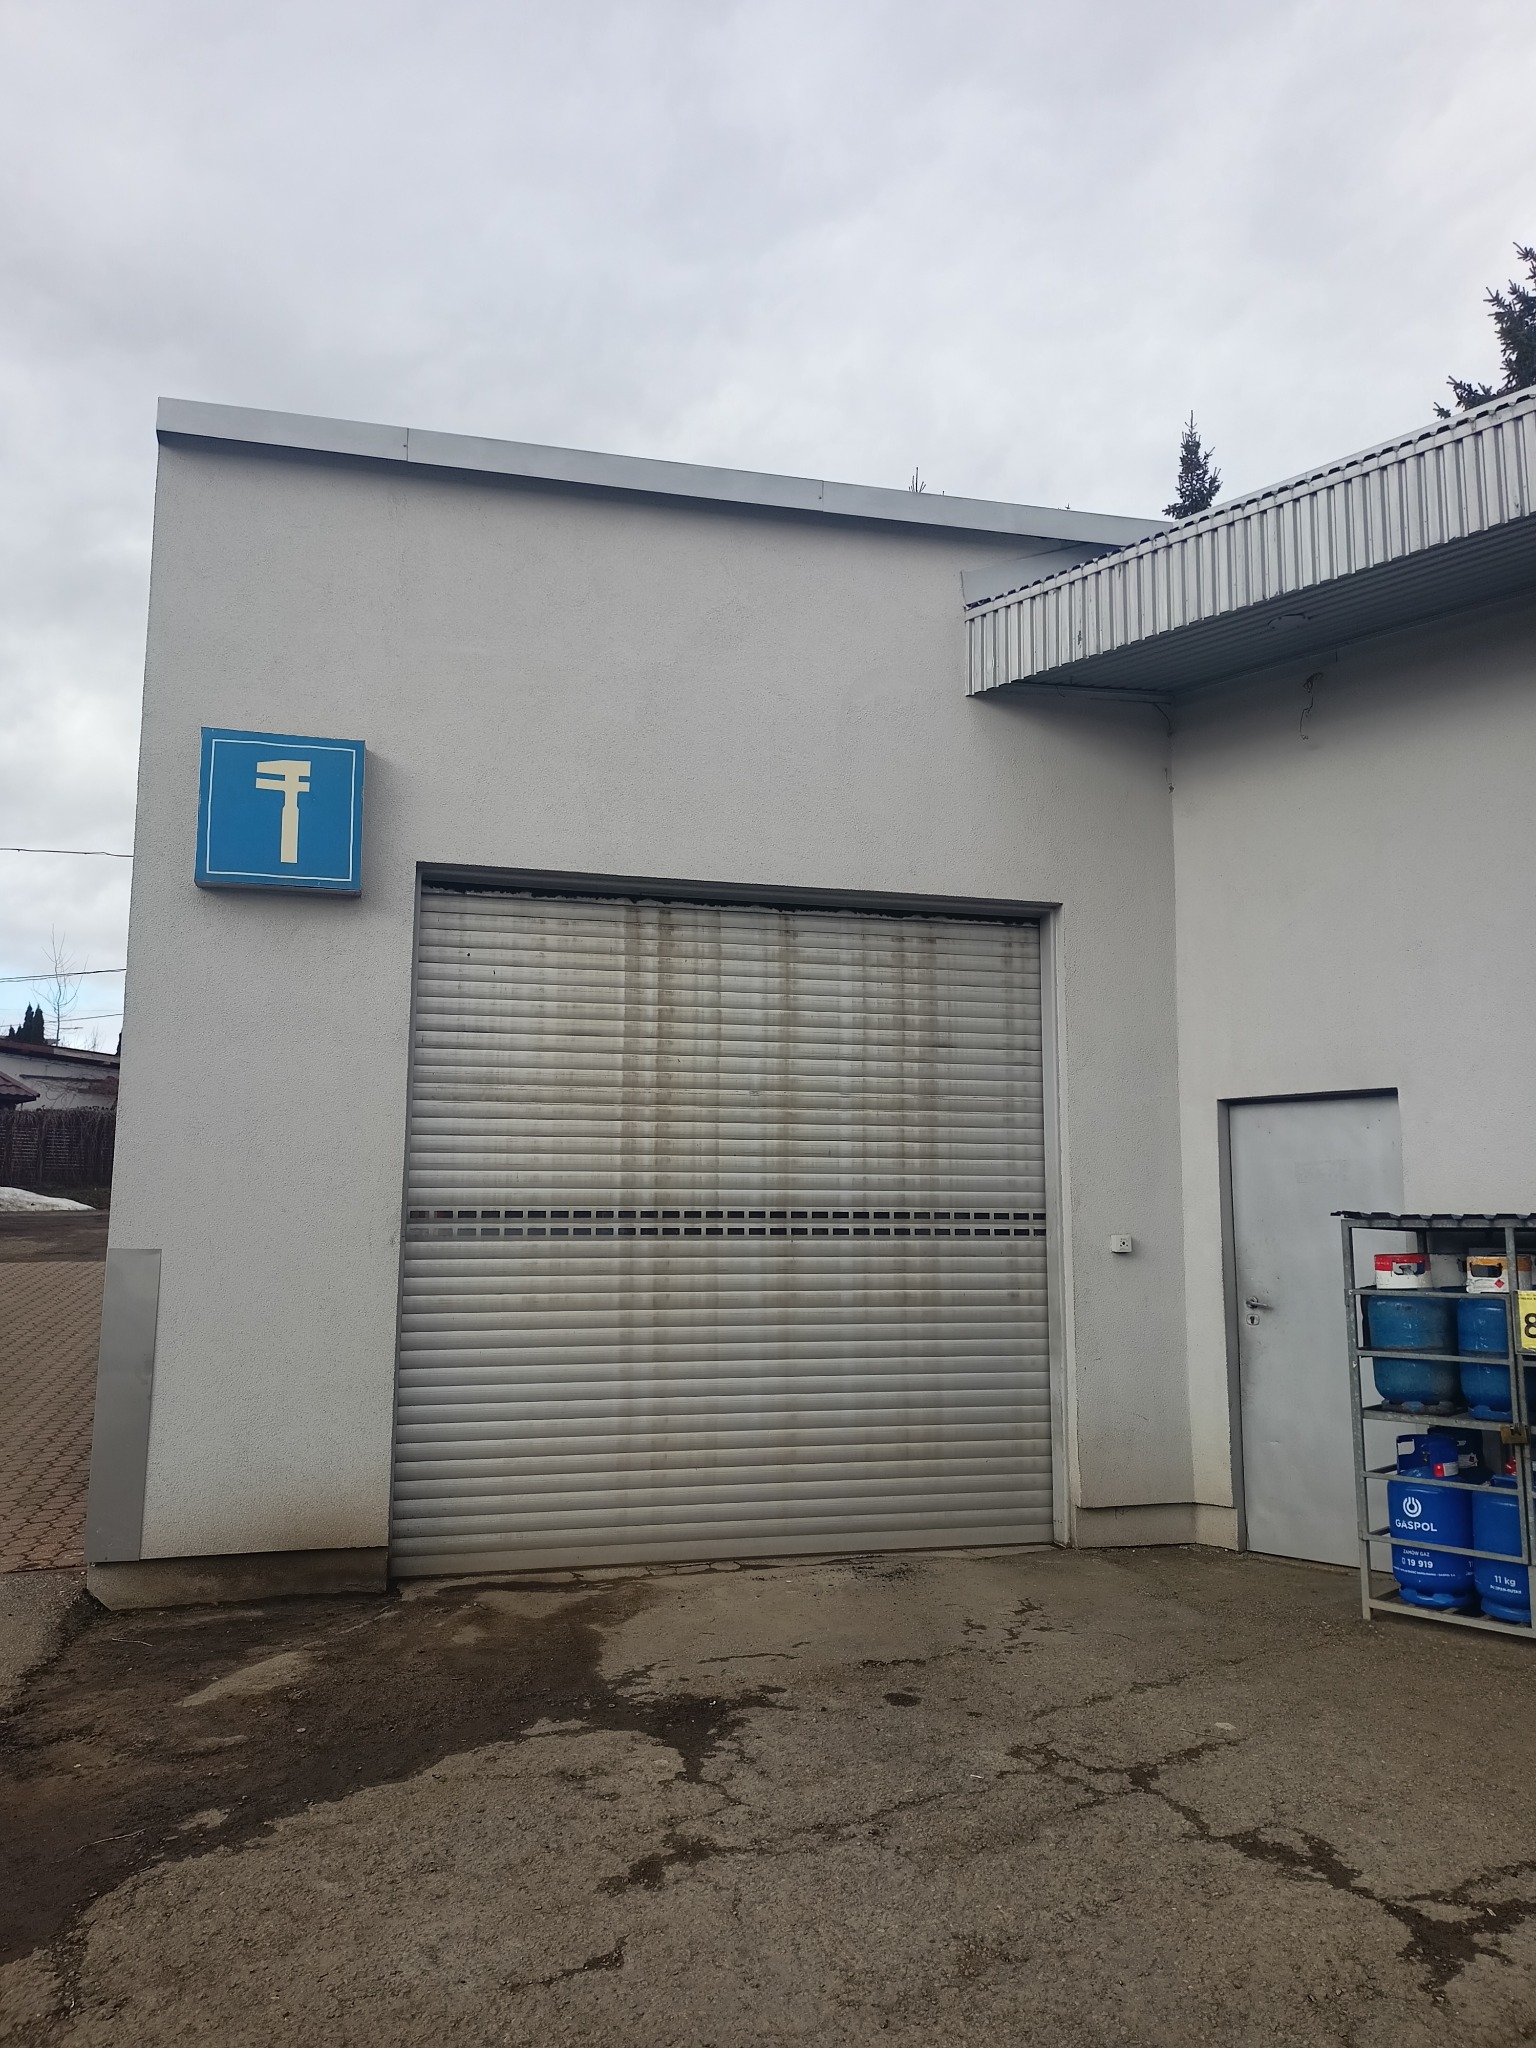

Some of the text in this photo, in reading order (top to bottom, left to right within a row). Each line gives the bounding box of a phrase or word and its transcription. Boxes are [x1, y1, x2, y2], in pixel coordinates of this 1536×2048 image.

[1395, 1519, 1438, 1532] GASPOL
[1407, 1558, 1433, 1569] 19 919
[1494, 1575, 1502, 1584] 11
[1504, 1576, 1516, 1588] kg
